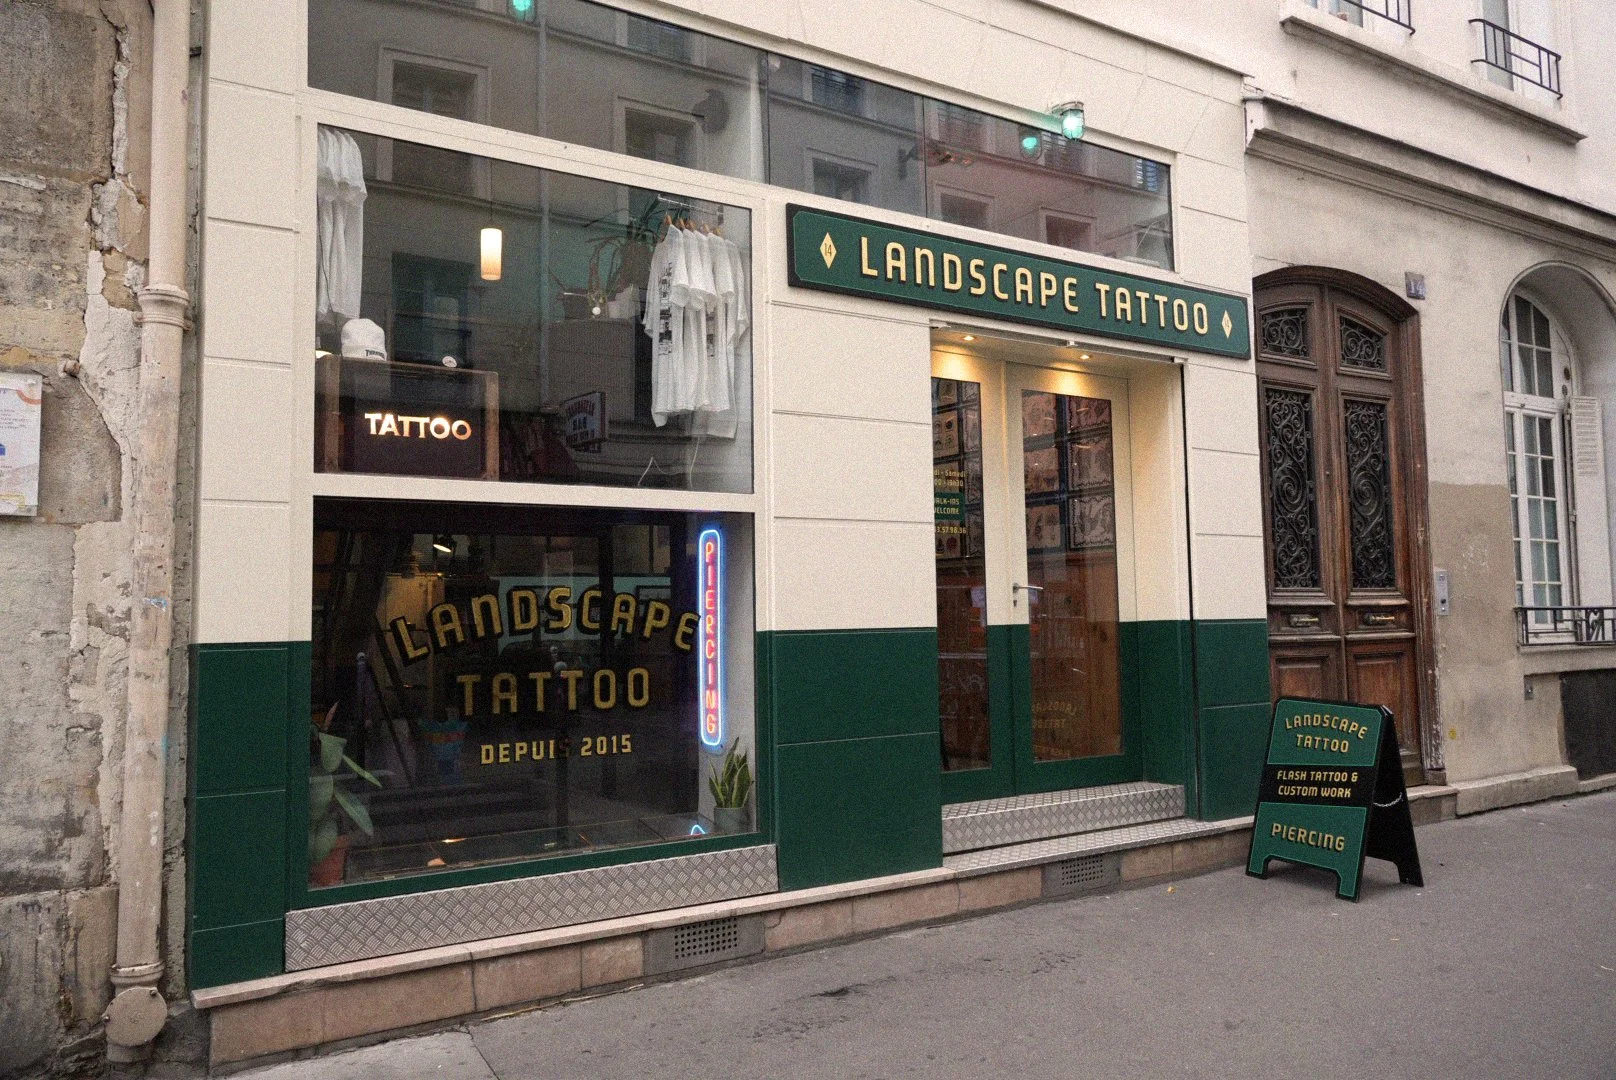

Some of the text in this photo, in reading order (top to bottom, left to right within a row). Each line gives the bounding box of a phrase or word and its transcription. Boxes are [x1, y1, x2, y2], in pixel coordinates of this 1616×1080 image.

[824, 242, 832, 257] 14
[860, 236, 1209, 336] LANDSCAPE TATTOO
[364, 412, 472, 440] TATTOO
[394, 587, 699, 662] LANDSCAPE
[705, 541, 718, 734] PIERCING
[456, 667, 651, 717] TATTOO
[1285, 713, 1368, 740] LANDSCAPE
[580, 733, 632, 757] 2015
[1296, 733, 1350, 754] TATTOO
[1276, 769, 1359, 783] FLASH TATTOO &
[1278, 785, 1352, 798] CUSTOM WORK
[1271, 822, 1345, 852] PIERCING
